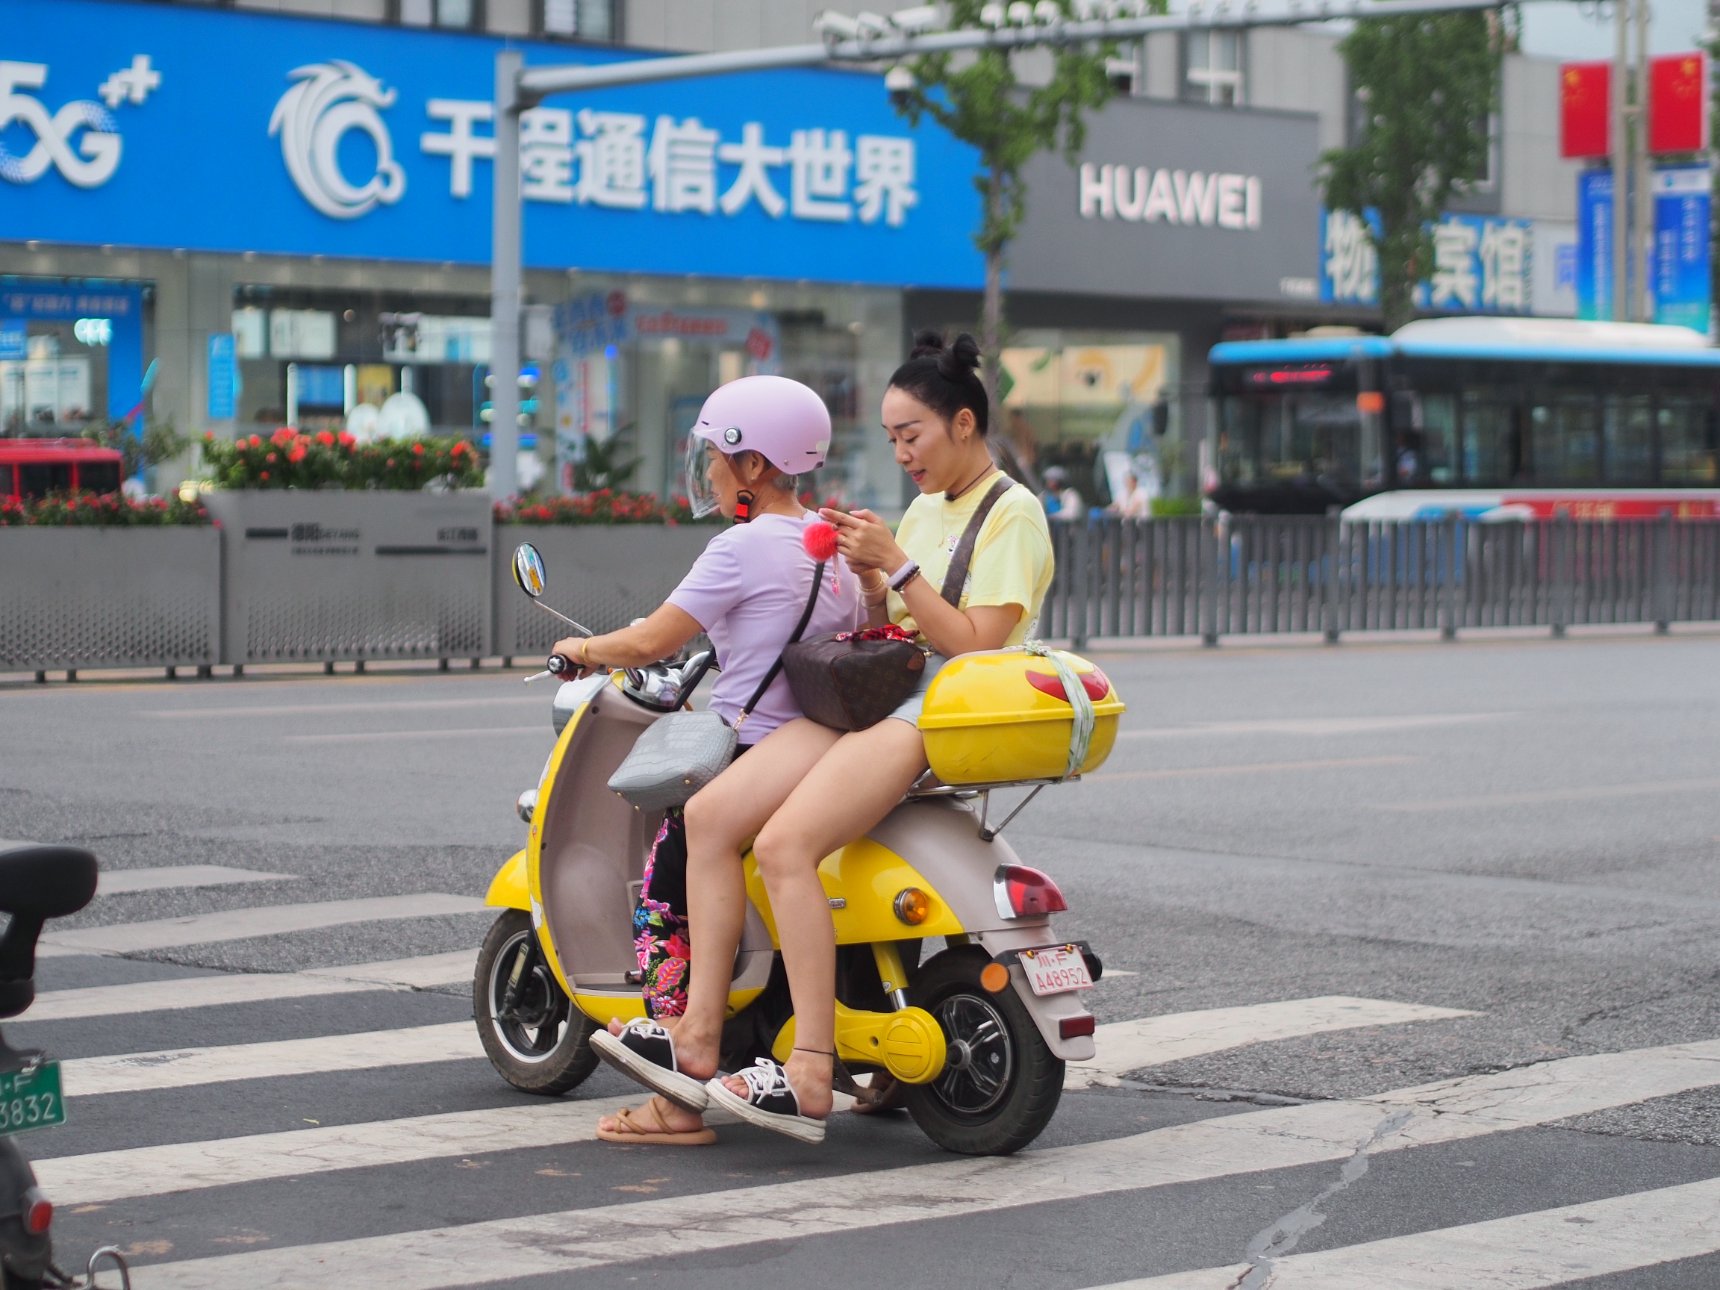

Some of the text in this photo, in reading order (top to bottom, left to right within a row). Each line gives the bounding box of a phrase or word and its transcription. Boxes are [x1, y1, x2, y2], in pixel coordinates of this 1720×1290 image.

[1080, 162, 1261, 230] HUAWEI
[1326, 208, 1526, 308] 物宾馆
[1035, 967, 1087, 991] A48952
